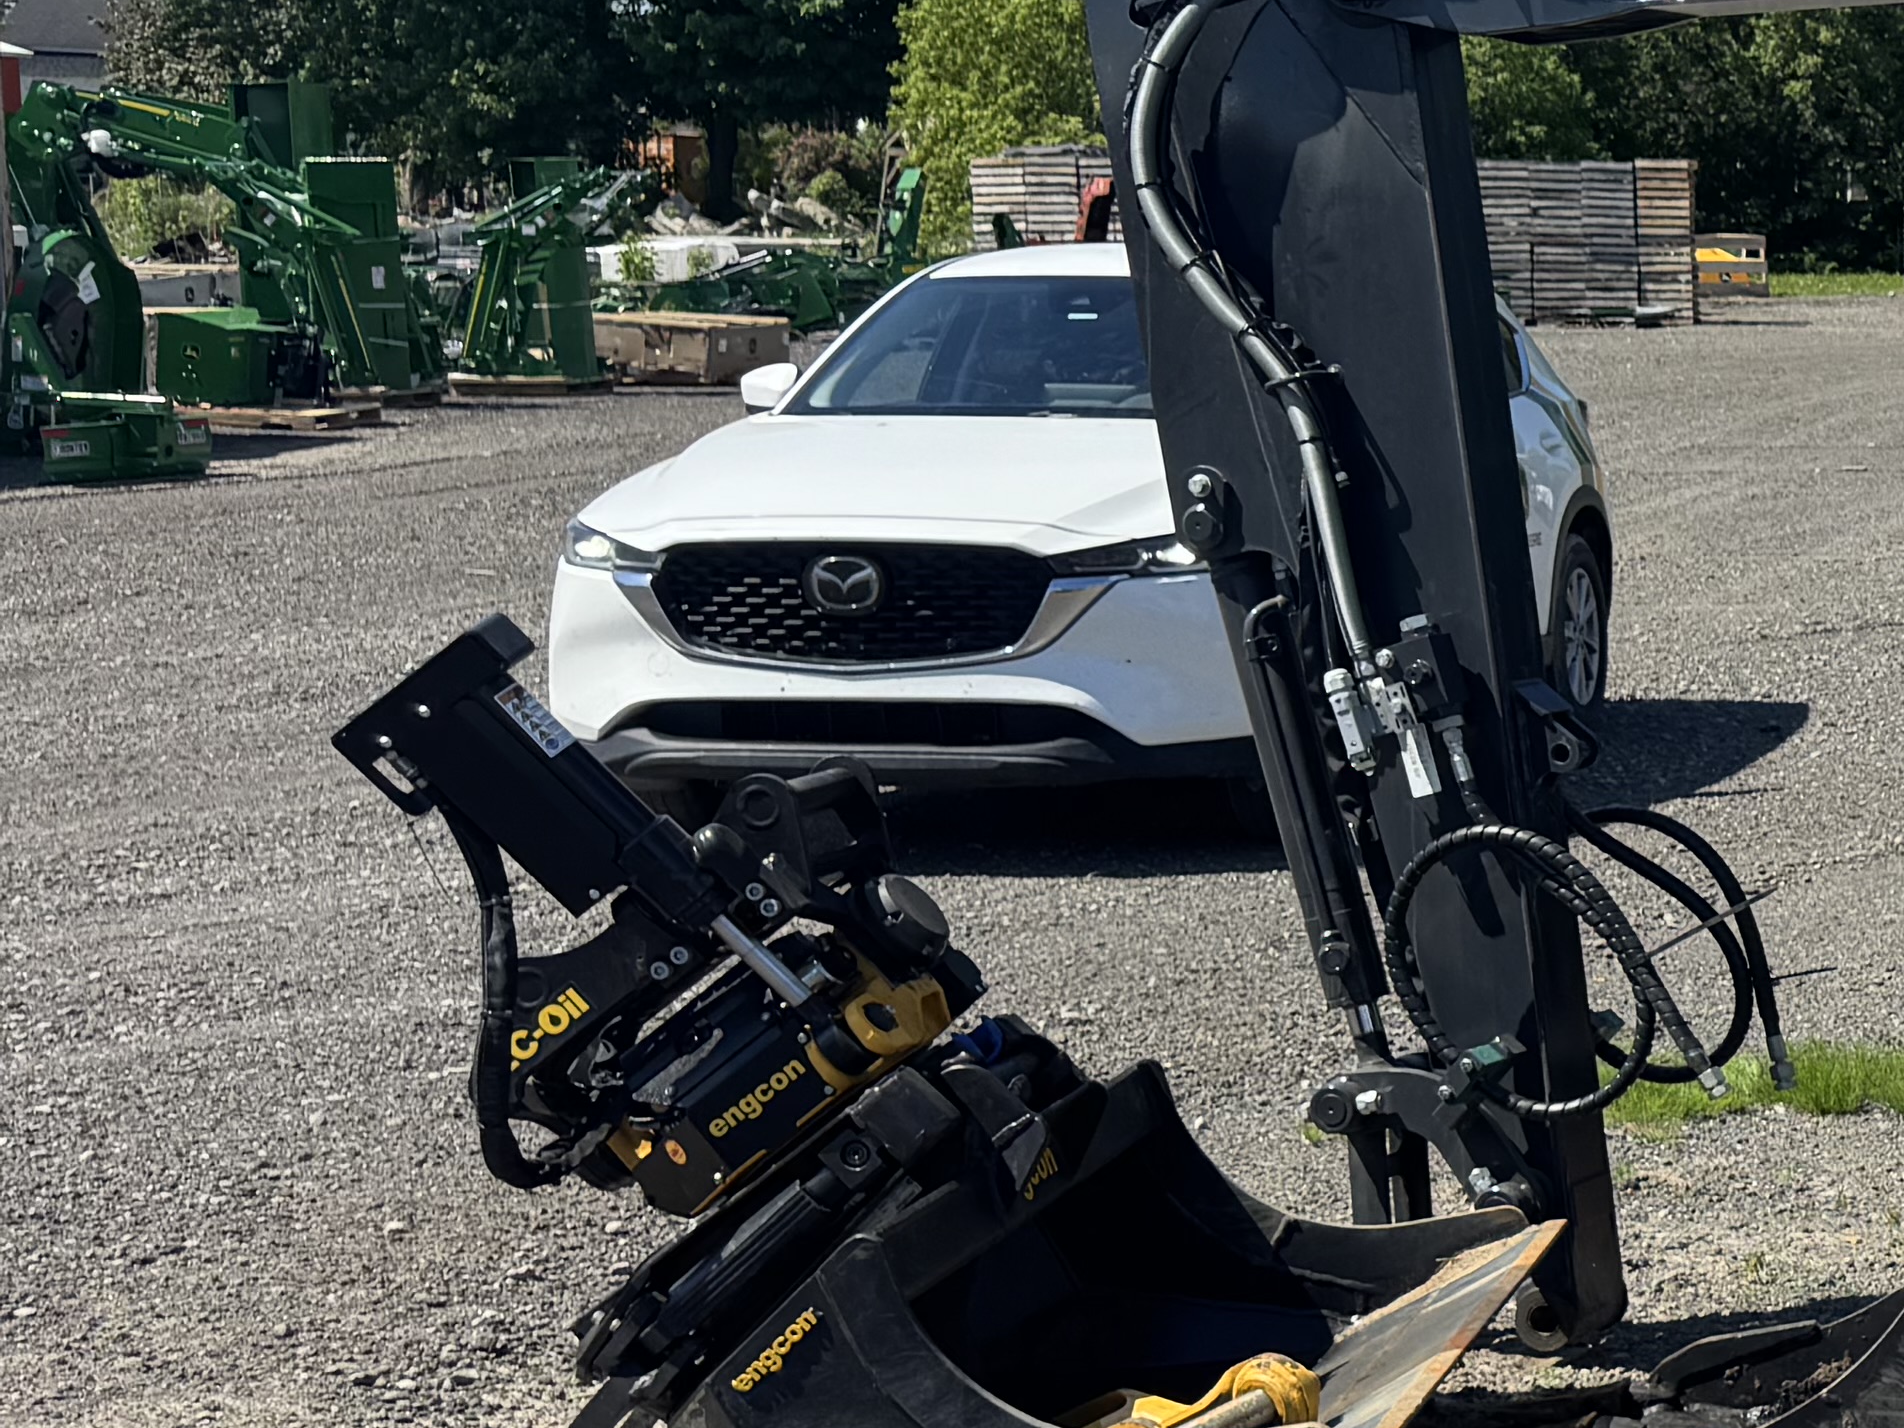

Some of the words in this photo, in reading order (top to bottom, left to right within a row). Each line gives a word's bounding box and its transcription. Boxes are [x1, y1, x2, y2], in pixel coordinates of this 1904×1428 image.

[510, 986, 590, 1072] C-Oil
[708, 1058, 806, 1138] engcon
[731, 1306, 818, 1392] engcon
